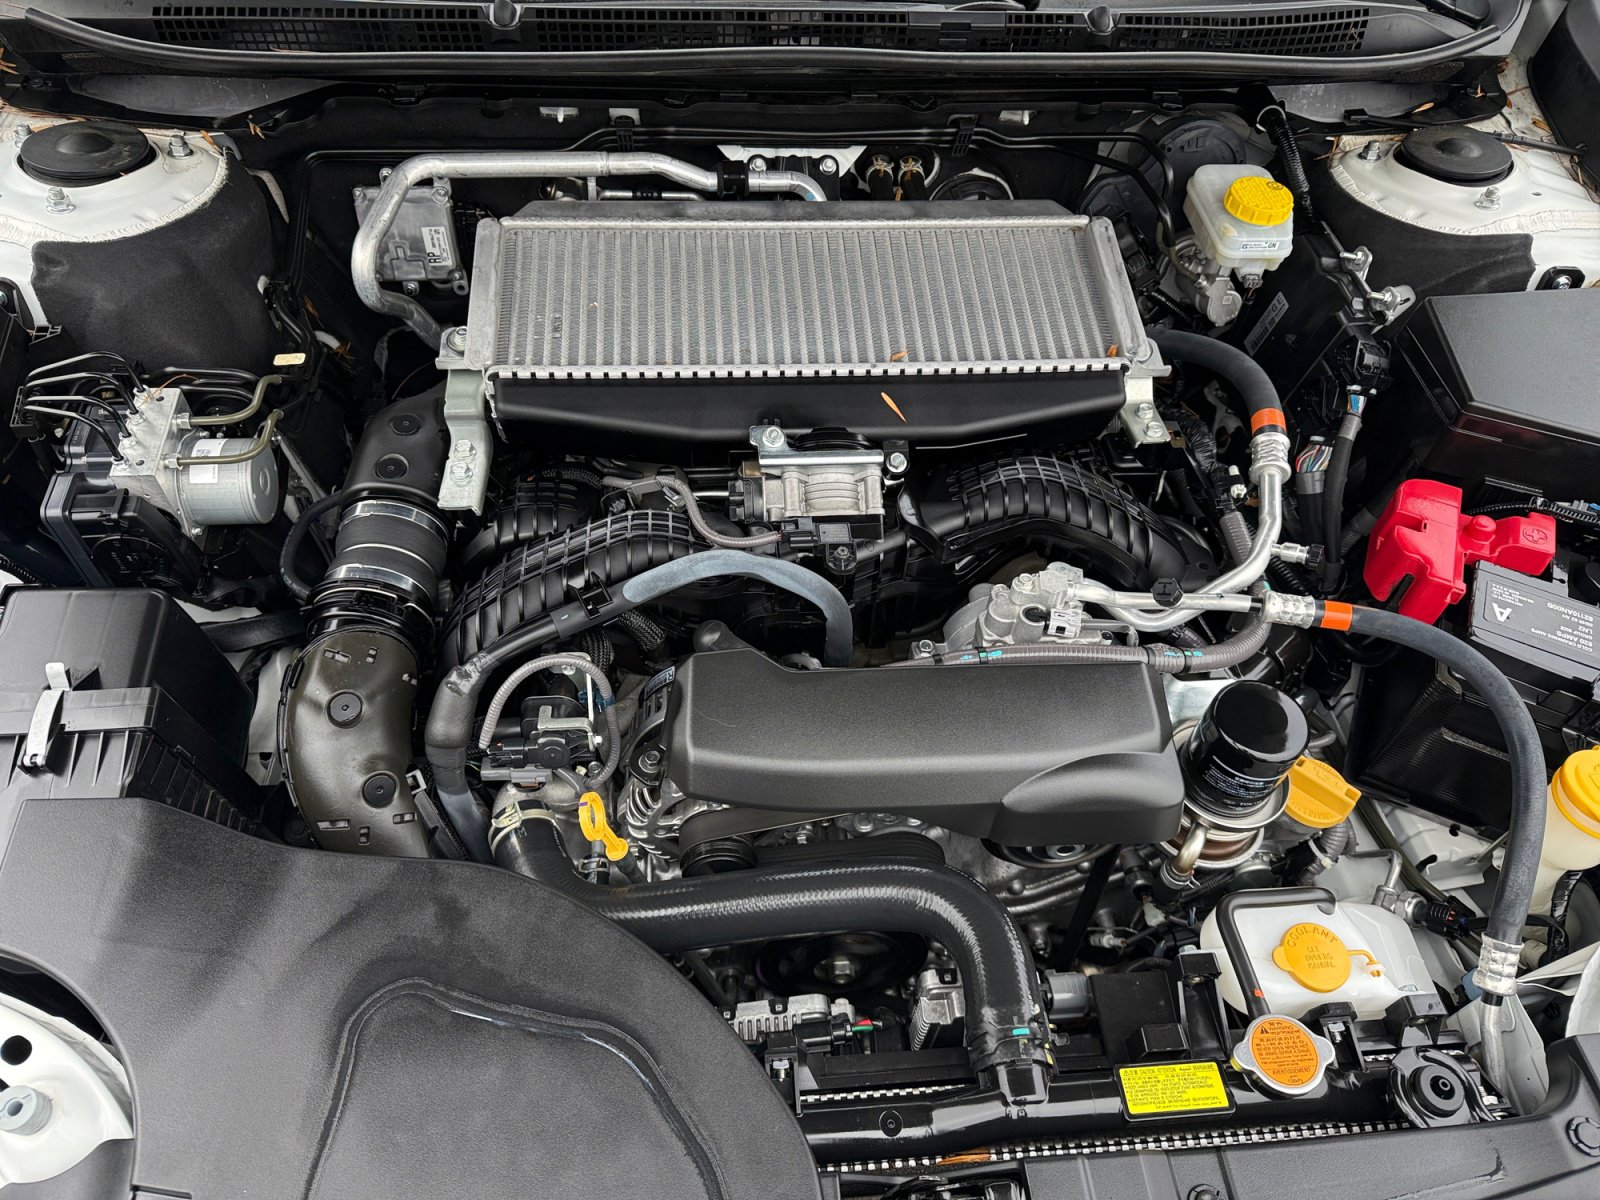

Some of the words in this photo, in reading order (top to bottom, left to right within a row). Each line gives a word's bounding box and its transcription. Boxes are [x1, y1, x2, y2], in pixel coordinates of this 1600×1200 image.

[427, 251, 442, 264] RP
[1491, 602, 1513, 623] A
[1531, 627, 1547, 637] AMPS
[1560, 625, 1573, 634] SIZE
[1578, 625, 1593, 635] LN2
[1556, 630, 1579, 643] AMPS
[1573, 630, 1593, 641] GROUP
[1576, 643, 1593, 653] COLD
[1286, 925, 1338, 948] COOLANT
